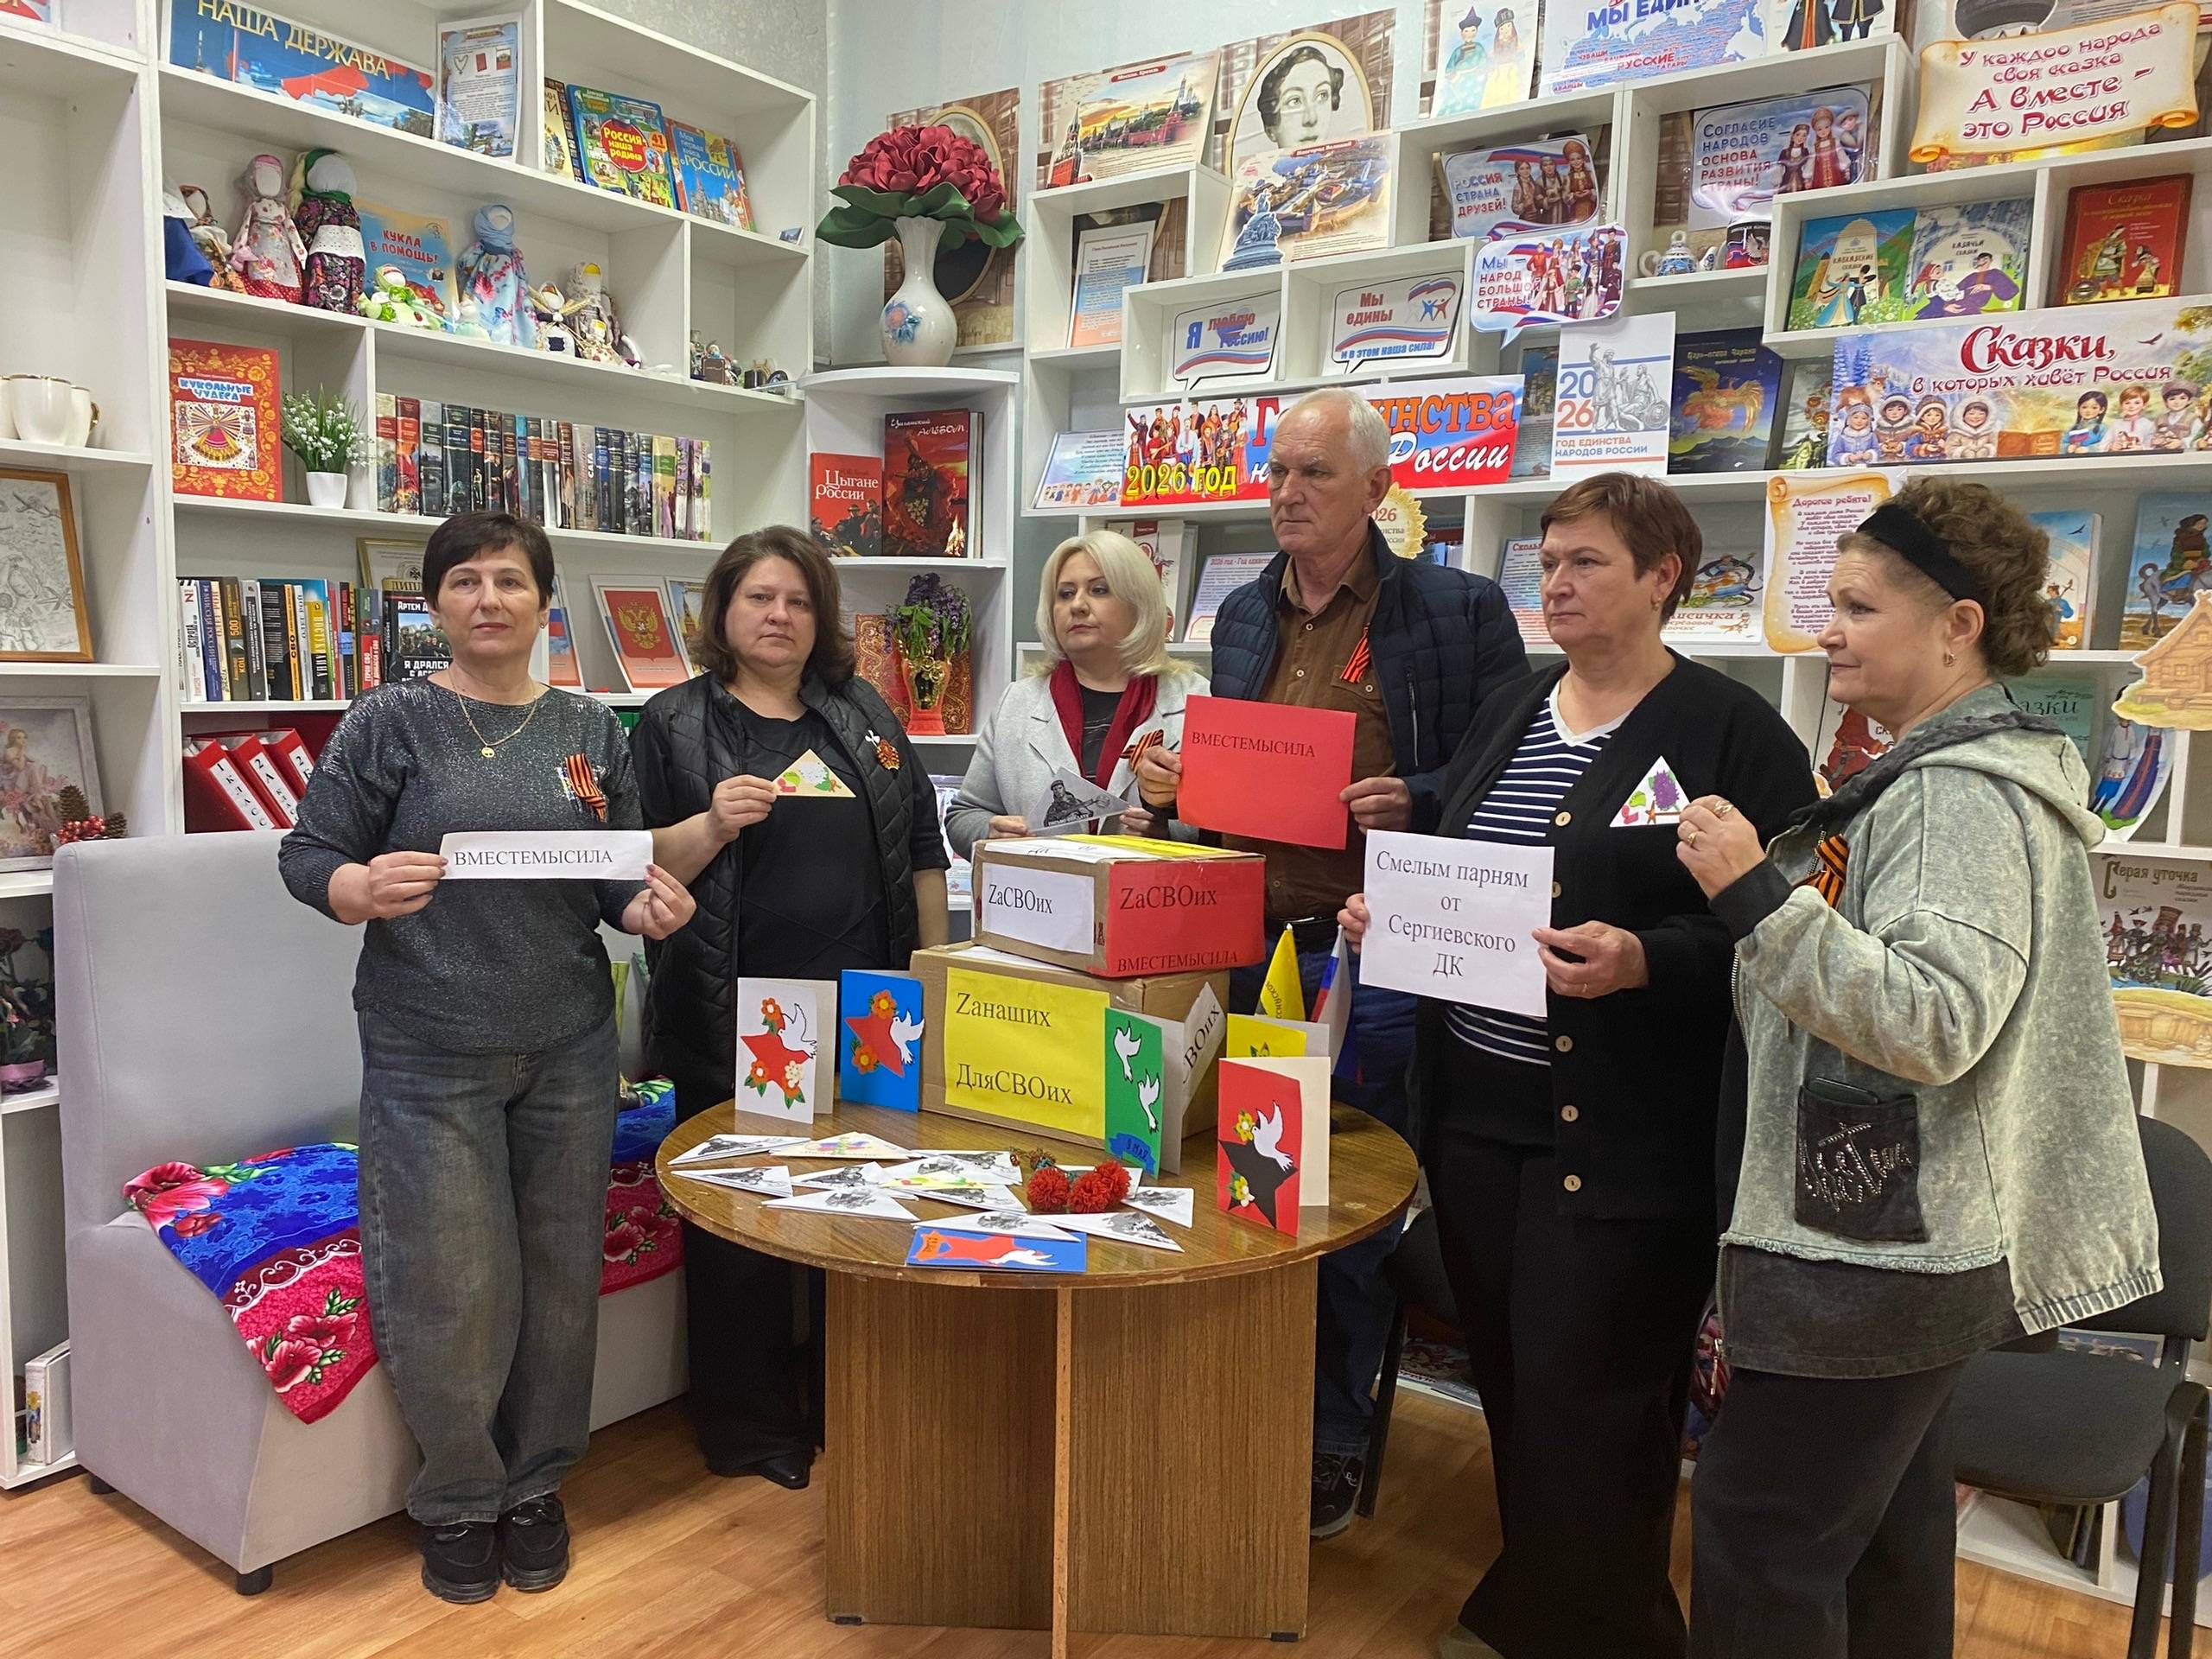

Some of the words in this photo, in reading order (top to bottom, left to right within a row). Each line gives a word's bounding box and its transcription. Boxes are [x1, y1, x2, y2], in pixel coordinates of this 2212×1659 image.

[1587, 3, 1629, 31] МЫ
[198, 0, 279, 41] НАША
[285, 24, 391, 80] ДЕРЖАВА
[1960, 51, 1976, 67] У
[2079, 23, 2161, 53] народа
[1617, 53, 1675, 71] РУССКИЕ
[1993, 67, 2040, 83] своя
[2049, 53, 2122, 75] сказка
[1969, 88, 1998, 111] А
[2010, 76, 2121, 108] вместе
[1963, 122, 2011, 137] это
[2022, 100, 2127, 134] Россия
[608, 138, 632, 151] наша
[1702, 135, 1770, 152] НАРОДОВ
[610, 149, 643, 162] родина
[1701, 149, 1758, 166] ОСНОВА
[685, 154, 735, 181] РОССИИ
[1700, 161, 1771, 180] РАЗВИТИЯ
[1453, 172, 1503, 190] РОССИЯ
[1456, 188, 1500, 202] СТРАНА
[1458, 198, 1506, 218] ДРУЗЕЙ!
[383, 230, 422, 248] КУКЛА
[370, 241, 378, 251] В
[382, 243, 438, 264] ПОМОЩЬ!
[1480, 270, 1522, 283] НАРОД
[1478, 276, 1541, 297] БОЛЬШОЙ
[1359, 292, 1383, 308] Мы
[1477, 294, 1531, 308] СТРАНЫ!
[1346, 308, 1393, 326] едины
[1186, 321, 1203, 349] Я
[1207, 311, 1255, 331] люблю
[1357, 347, 1380, 359] этом
[1382, 344, 1407, 356] наша
[1408, 340, 1435, 353] сила!
[1960, 324, 2116, 374] Сказки,
[180, 378, 251, 394] КУКОЛЬНЫЕ
[1559, 370, 1597, 399] 20
[1912, 378, 1923, 394] в
[1932, 373, 2017, 392] которых
[2023, 367, 2086, 388] живёт
[2093, 365, 2172, 384] Россия
[194, 389, 239, 401] ЧУДЕСА
[1557, 399, 1594, 429] 26
[1555, 447, 1603, 457] НАРОДОВ
[1605, 445, 1648, 455] РОССИИ
[1556, 439, 1576, 448] ГОД
[1579, 435, 1632, 447] ЕДИНСТВА
[1389, 431, 1510, 472] России
[825, 469, 879, 493] Цыгане
[1126, 462, 1185, 497] 2026
[816, 484, 864, 500] России
[229, 620, 239, 636] 500
[404, 661, 411, 670] Я
[413, 661, 449, 671] ДРАЛСЯ
[2019, 700, 2079, 715] азки
[1192, 731, 1316, 759] ВМЕСТЕМЫСИЛА
[254, 759, 264, 769] 2
[296, 755, 304, 766] 2
[454, 848, 613, 868] ВМЕСТЕМЫСИЛА
[1376, 850, 1452, 878] Смелым
[1457, 865, 1529, 888] парням
[2152, 868, 2198, 885] уточка
[1440, 896, 1461, 912] от
[1389, 914, 1516, 952] Сергиевского
[1117, 950, 1238, 973] ВМЕСТЕМЫСИЛА
[1433, 953, 1464, 978] ДК
[1183, 1004, 1220, 1084] ВОих
[955, 1063, 1074, 1106] ДляСВОих
